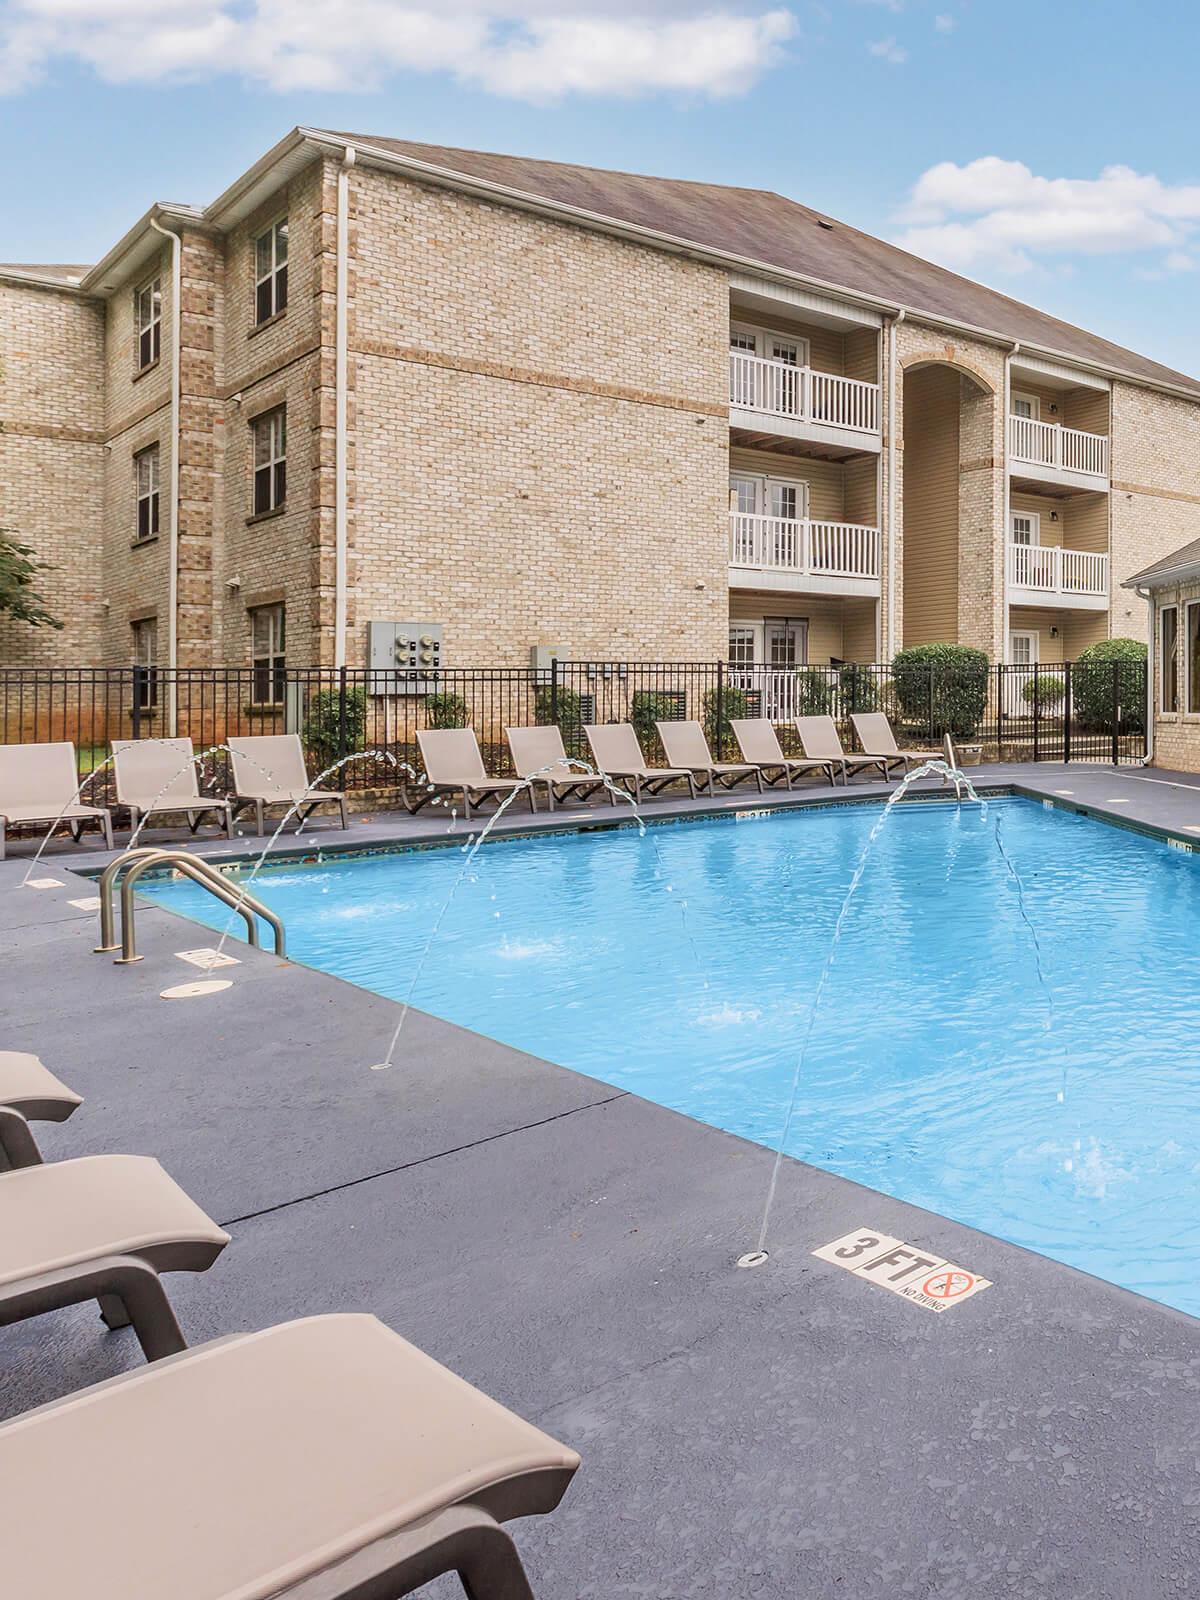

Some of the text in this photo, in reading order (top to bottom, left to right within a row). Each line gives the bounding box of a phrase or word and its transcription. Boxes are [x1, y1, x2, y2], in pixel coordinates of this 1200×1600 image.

[219, 865, 238, 873] FT
[835, 1237, 937, 1282] 3 FT
[900, 1286, 946, 1311] NO DIVING
